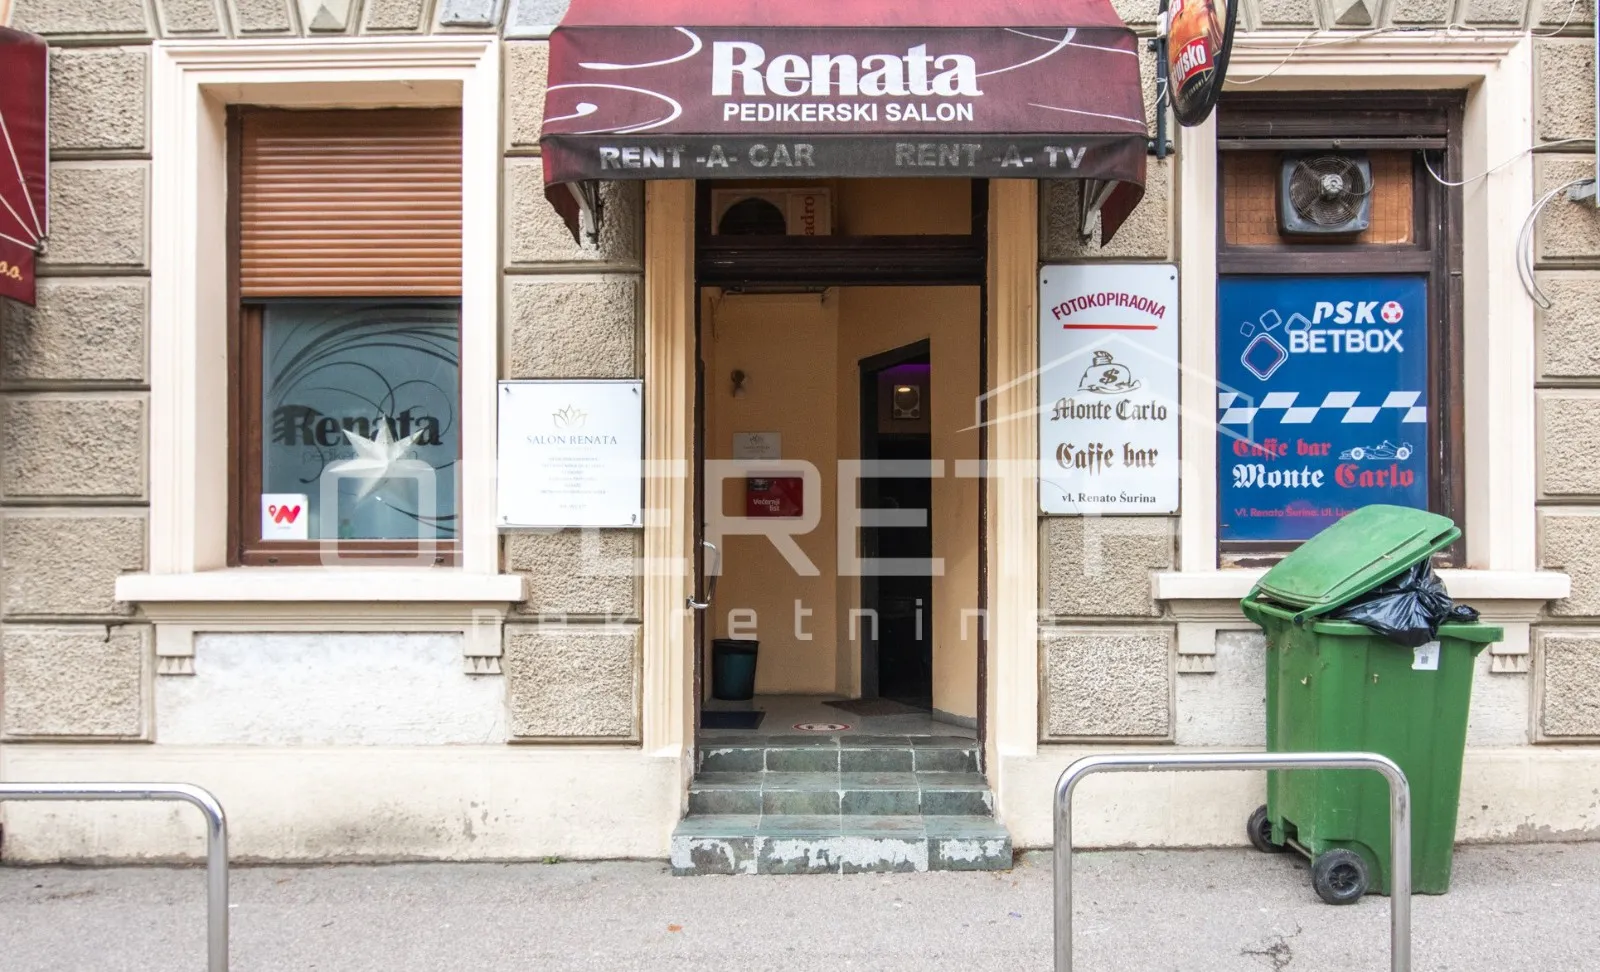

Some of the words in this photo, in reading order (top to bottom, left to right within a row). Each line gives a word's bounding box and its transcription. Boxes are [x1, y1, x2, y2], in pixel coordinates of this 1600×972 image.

[711, 41, 984, 97] Renata
[723, 103, 878, 122] PEDIKERSKI
[885, 103, 974, 122] SALON
[599, 147, 683, 170] RENT
[696, 152, 738, 169] -A-
[748, 144, 816, 168] CAR
[895, 144, 982, 168] RENT
[993, 152, 1034, 169] -A-
[1043, 146, 1087, 170] TV
[1051, 292, 1167, 321] FOTOKOPIRAONA
[1312, 301, 1380, 325] PSK
[1289, 328, 1404, 353] BETBOX
[1050, 398, 1112, 422] Monte
[1115, 398, 1167, 421] Carlo
[526, 435, 566, 445] SALON
[569, 434, 618, 445] RENATA
[1232, 437, 1289, 461] Caffe
[1296, 438, 1332, 457] bar
[1055, 441, 1114, 477] Caffe
[1122, 442, 1159, 469] bar
[1232, 463, 1325, 489] Monte
[1334, 463, 1414, 488] Carlo
[1062, 492, 1075, 503] vl.
[1078, 493, 1117, 503] Renato
[1119, 491, 1157, 504] Šurina
[1250, 508, 1284, 517] Renato
